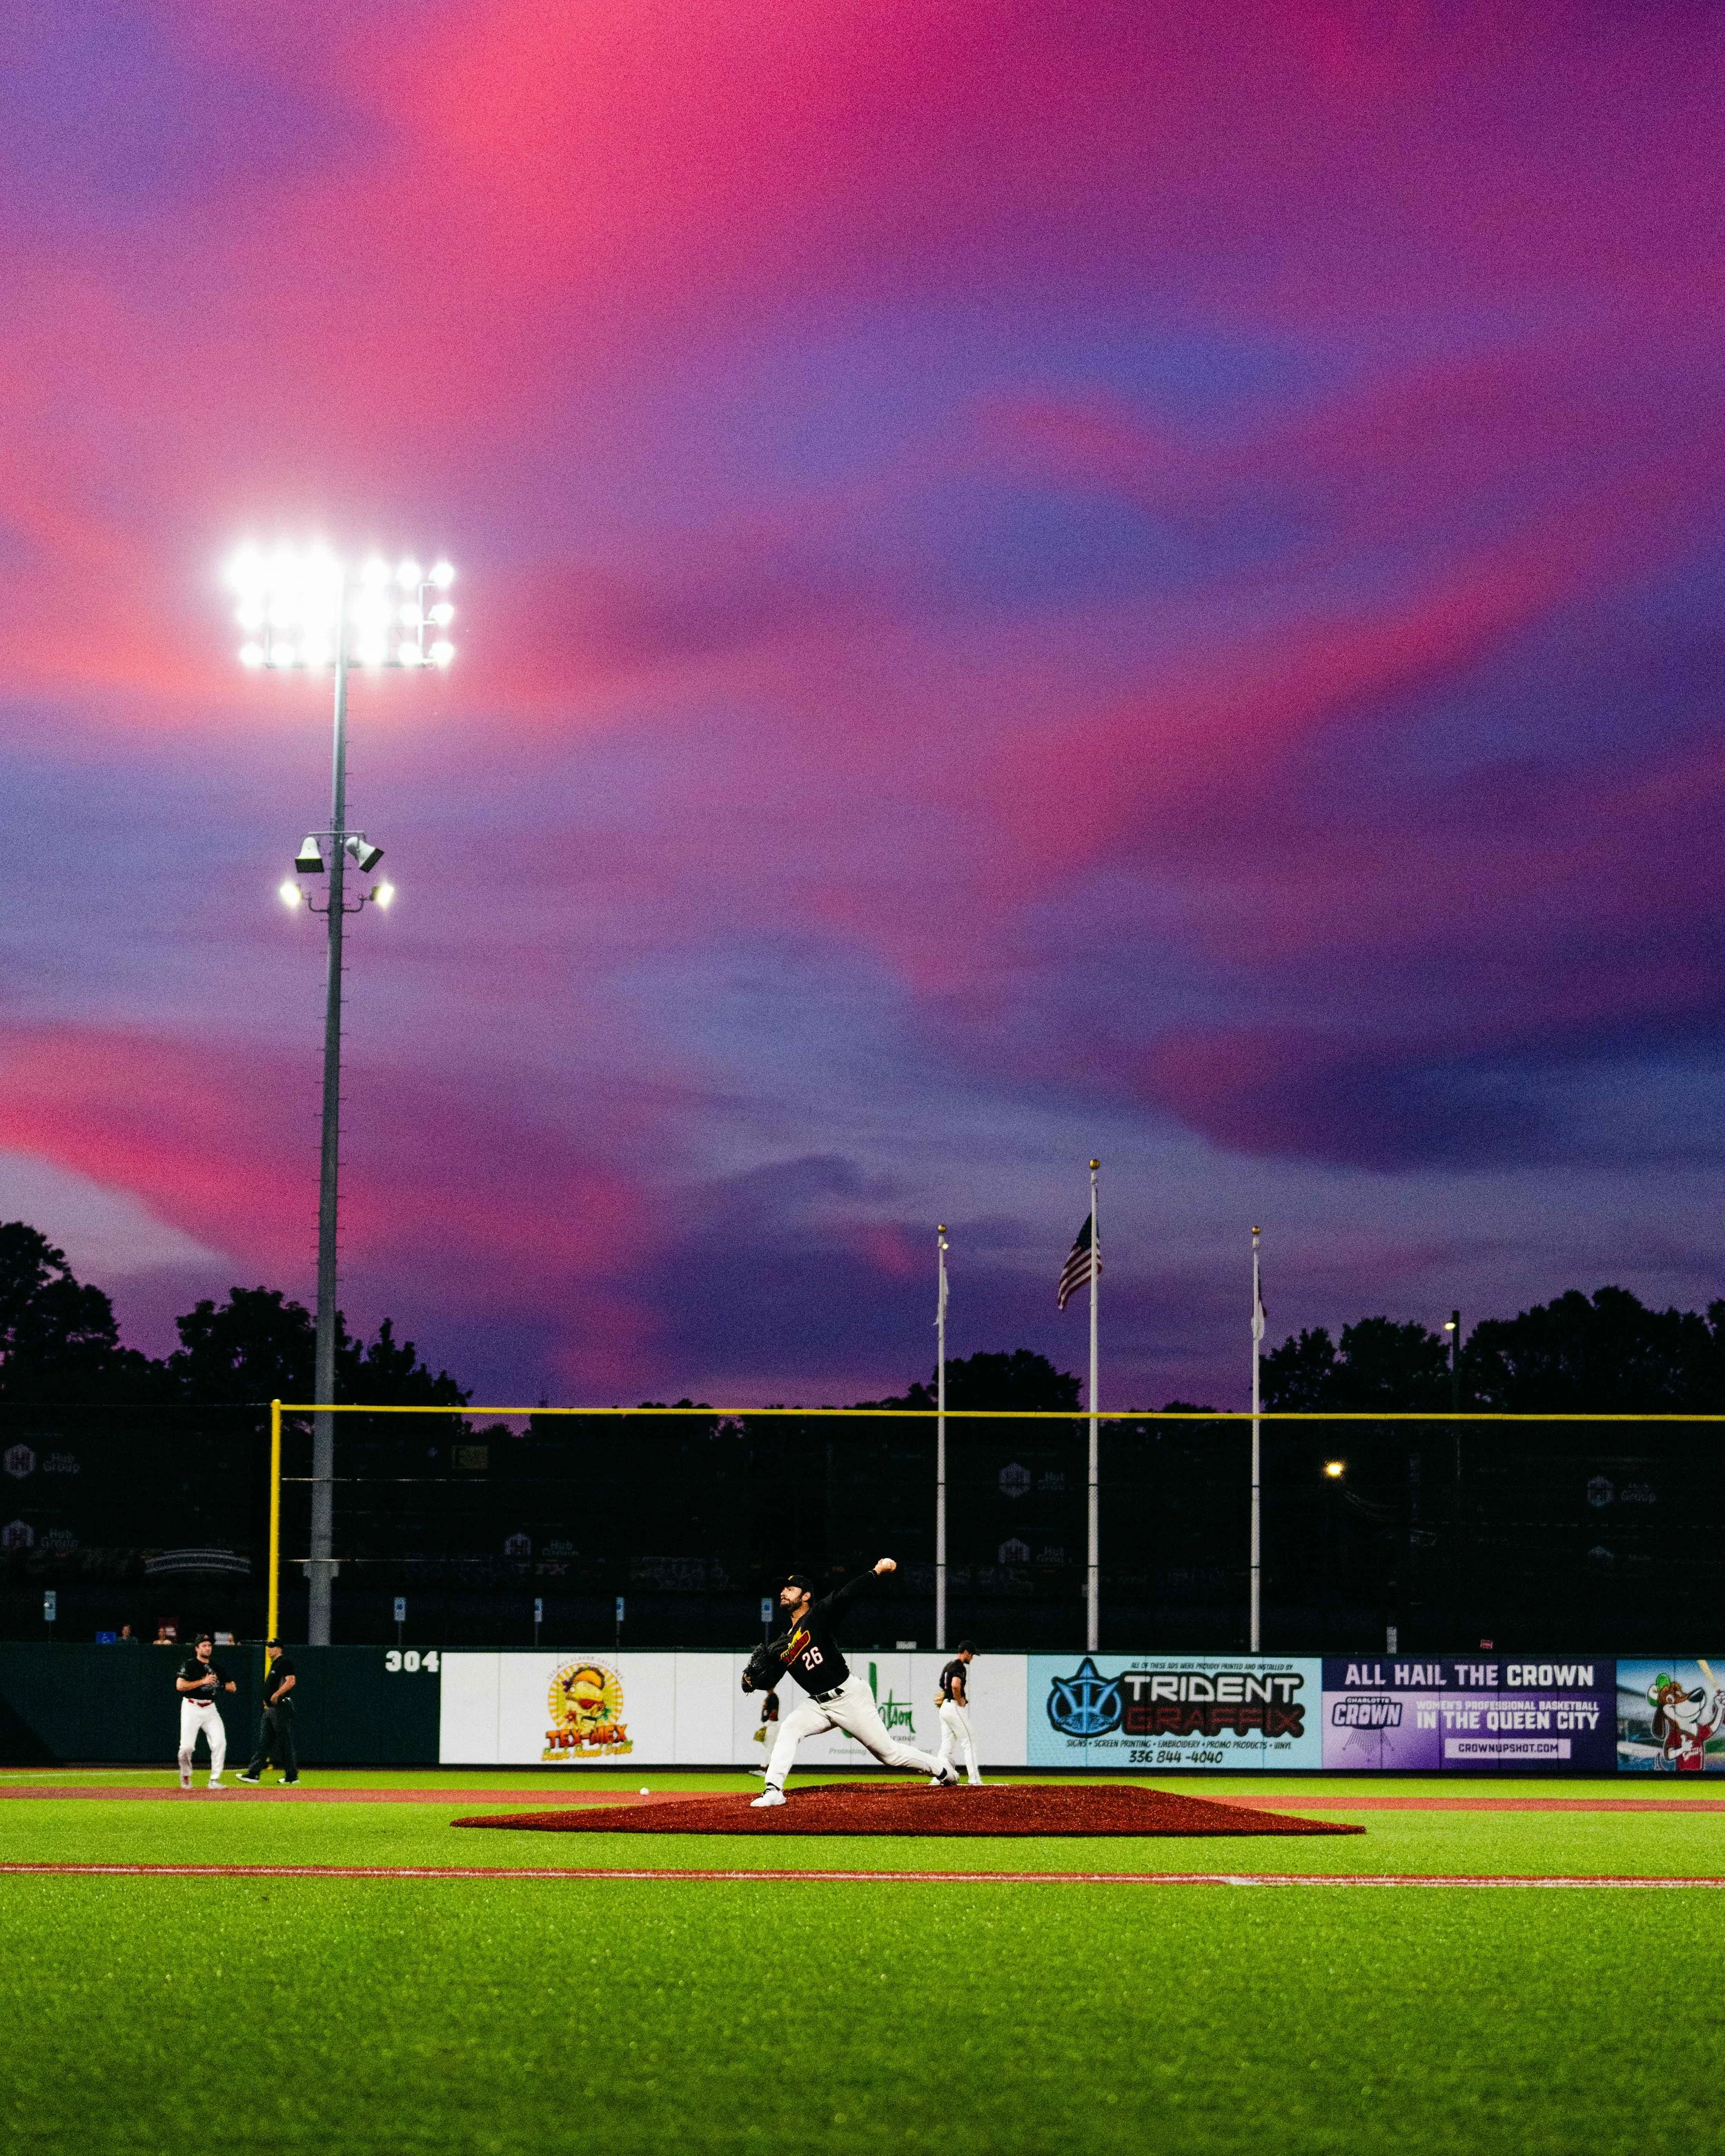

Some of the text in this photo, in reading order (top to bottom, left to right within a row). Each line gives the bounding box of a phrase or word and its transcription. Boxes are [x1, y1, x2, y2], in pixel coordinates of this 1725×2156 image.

[385, 1650, 440, 1672] 304
[802, 1646, 824, 1671] 26
[1345, 1664, 1593, 1686] ALL HAIL THE CROWN
[1123, 1675, 1301, 1703] TRIDENT
[1333, 1703, 1401, 1725] CROWN
[1416, 1701, 1599, 1711] WOMEN'S PROFESSIONAL BASKETBALL
[1125, 1705, 1301, 1731] GRAFFIX
[1417, 1711, 1600, 1730] IN THE QUEEN CITY
[546, 1723, 628, 1748] TEX-MEX
[1066, 1739, 1087, 1748] SIGNS
[1157, 1740, 1201, 1748] EMBROIDERY
[1232, 1741, 1268, 1749] PRODUCTS
[828, 1748, 867, 1756] Protecting
[1129, 1750, 1223, 1763] 336 844 -4040
[1459, 1743, 1559, 1753] CROWNUPSHOT.COM
